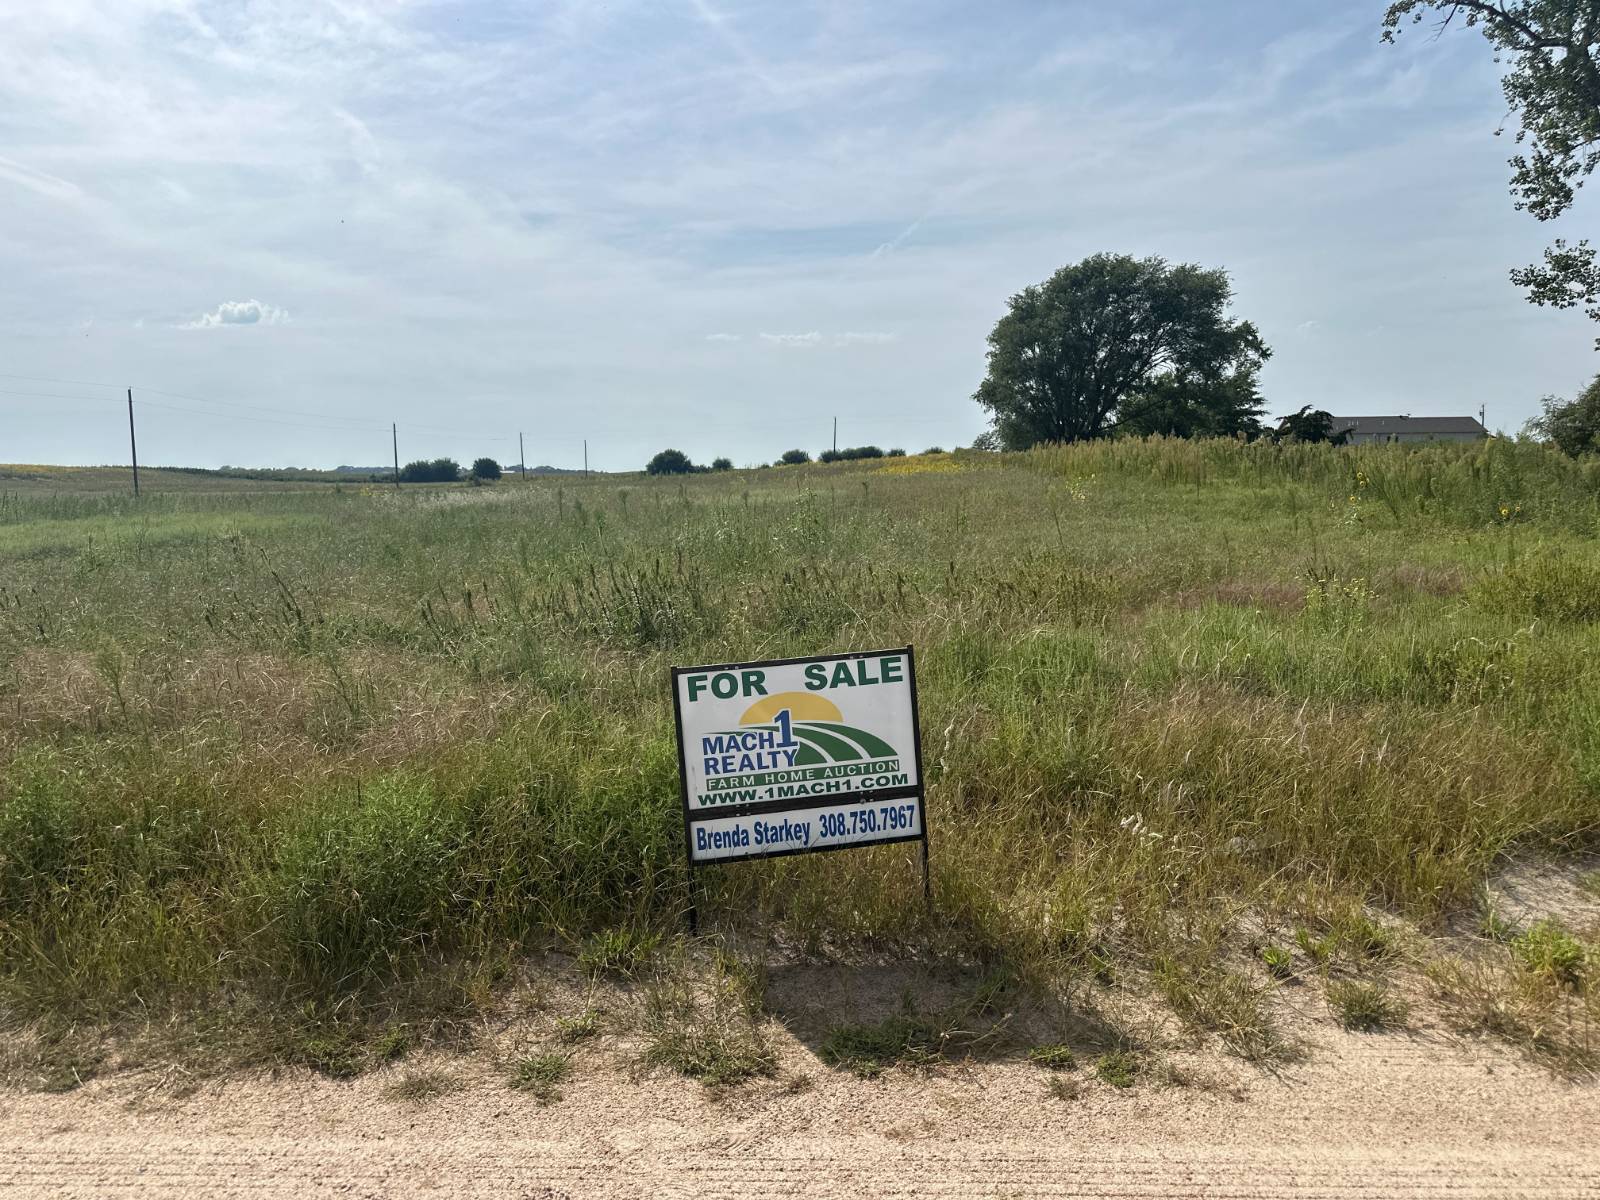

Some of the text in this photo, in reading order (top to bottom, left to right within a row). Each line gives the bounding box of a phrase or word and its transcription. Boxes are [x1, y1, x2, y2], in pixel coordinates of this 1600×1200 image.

[687, 656, 904, 702] FOR SALE
[702, 731, 774, 756] MACH
[703, 748, 799, 776] REALTY
[707, 760, 899, 790] FARM HOME AUCTION
[698, 773, 909, 807] WWW.1MACH1.COM
[696, 804, 915, 851] Brenda Starkey 308.750.7967
